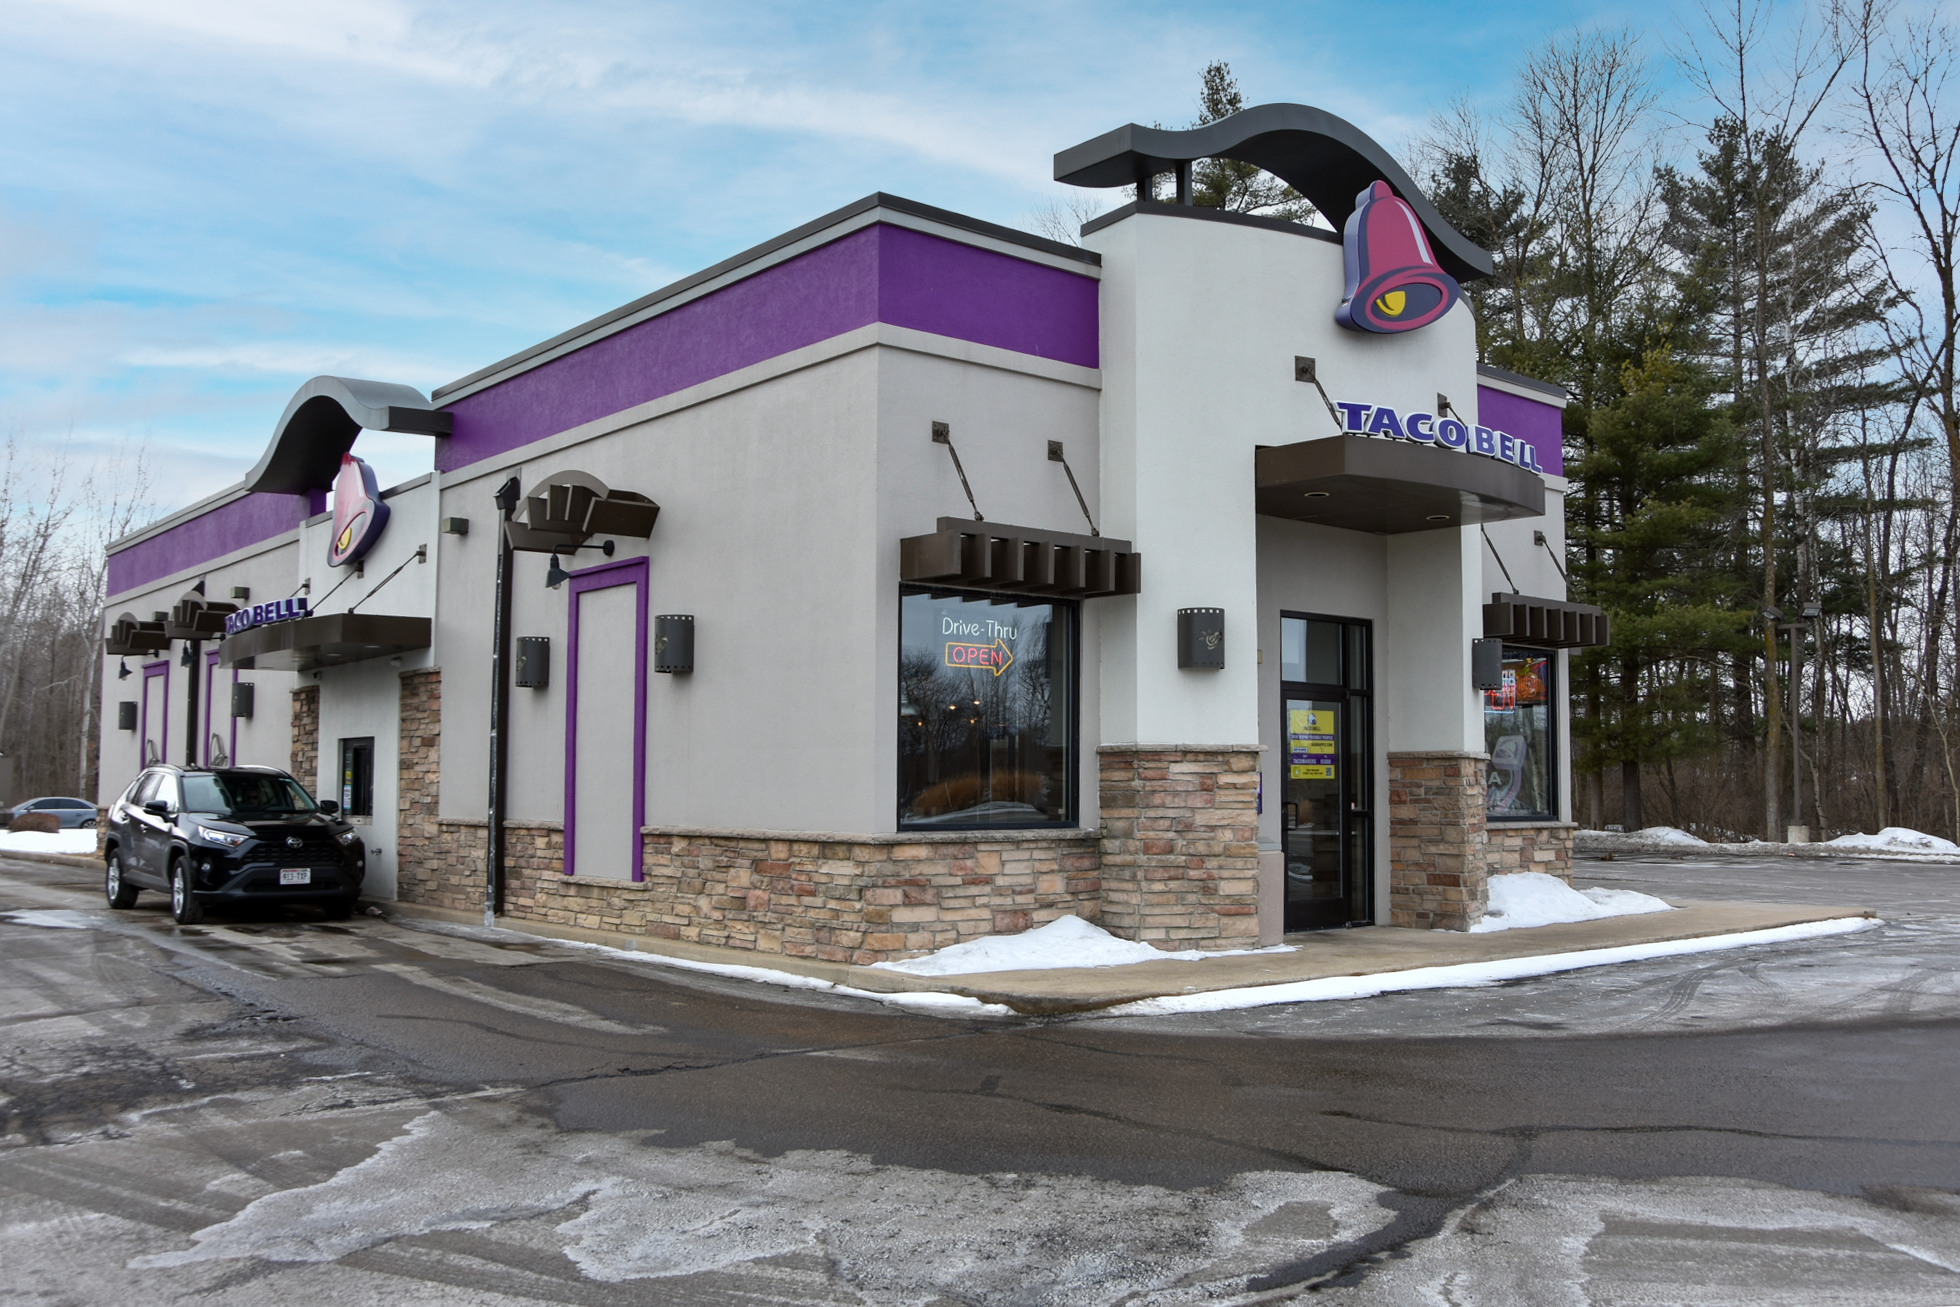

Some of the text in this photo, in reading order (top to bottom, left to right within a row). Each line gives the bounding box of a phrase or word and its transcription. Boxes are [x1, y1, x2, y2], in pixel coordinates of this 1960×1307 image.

[1331, 401, 1543, 475] TACO BELL
[224, 597, 304, 635] TACO BELL
[942, 616, 1018, 640] Drive-Thru
[953, 646, 1002, 666] OPEN
